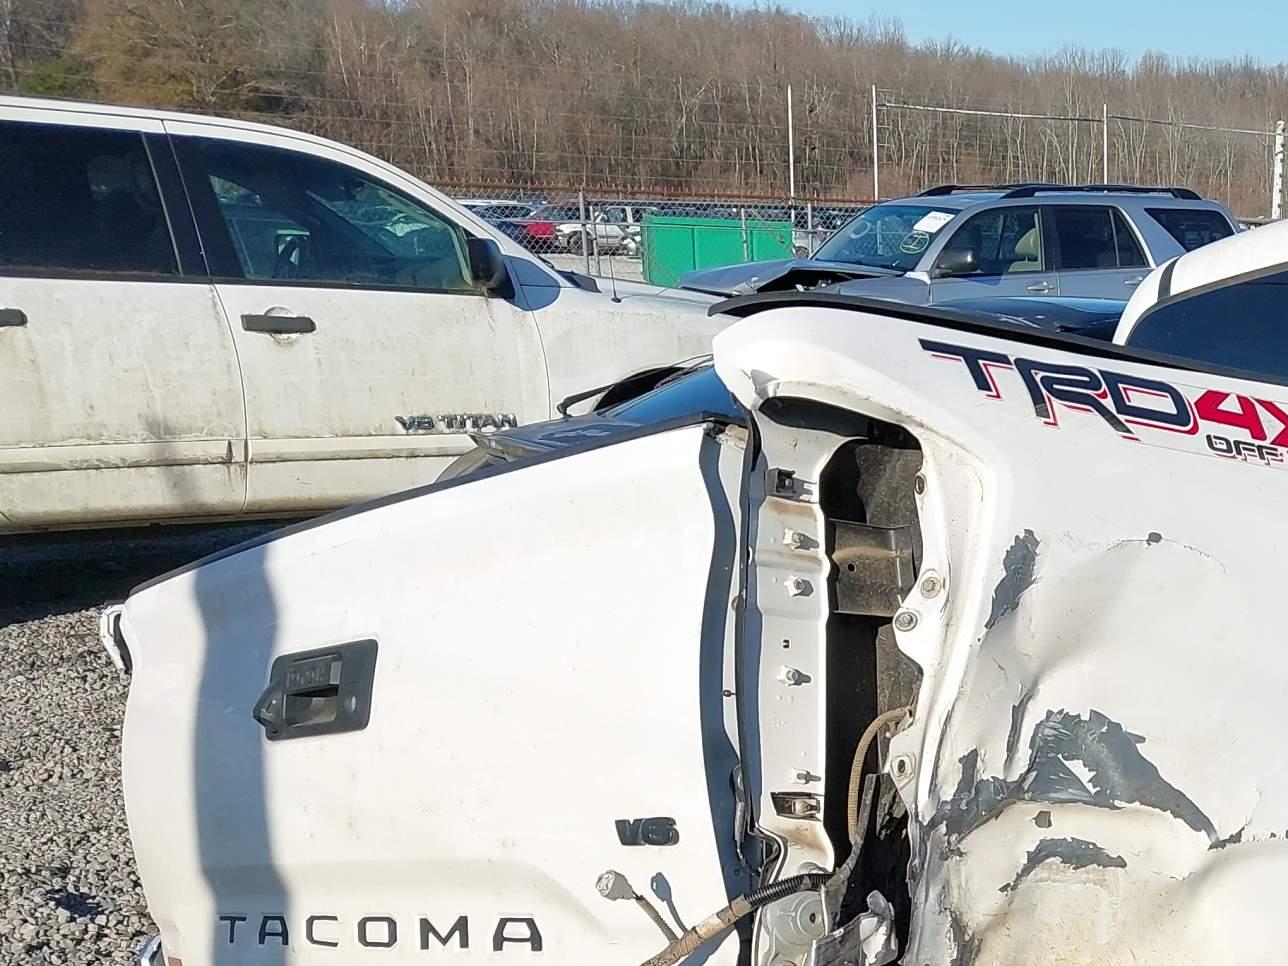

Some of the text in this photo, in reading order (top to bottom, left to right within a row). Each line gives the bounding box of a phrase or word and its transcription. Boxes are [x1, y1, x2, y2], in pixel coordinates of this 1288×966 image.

[918, 338, 1200, 442] TRD
[438, 414, 518, 430] TITAN
[1205, 432, 1284, 466] OFF
[615, 816, 680, 846] V6
[219, 915, 543, 952] TACOMA
